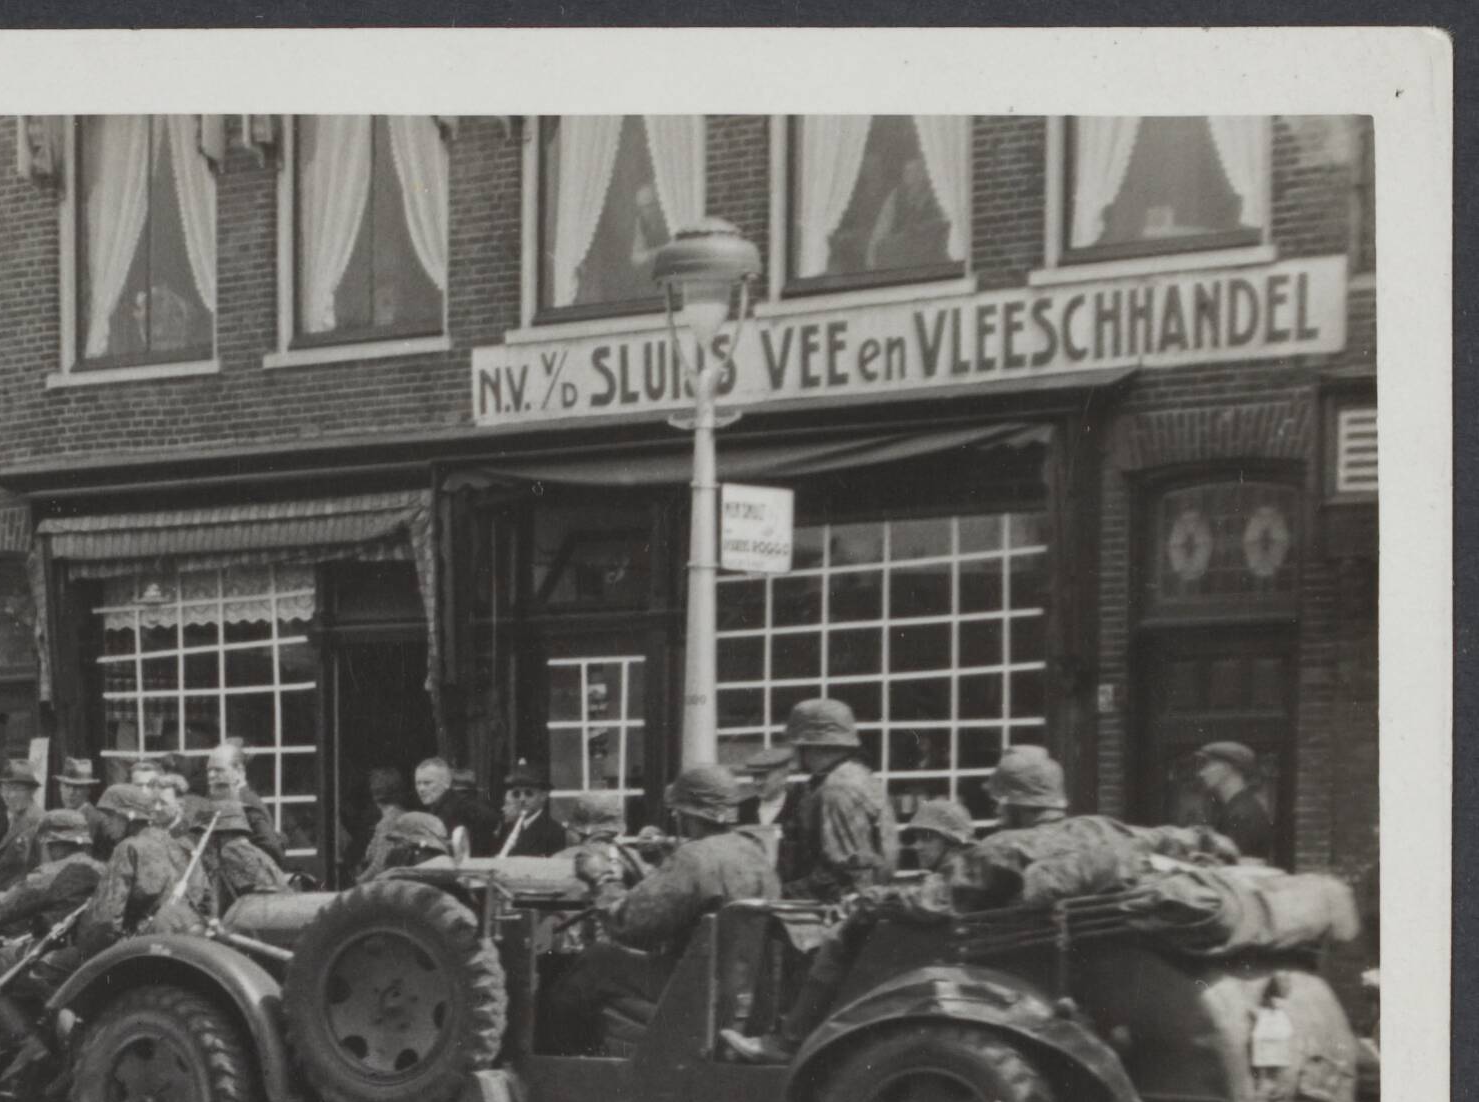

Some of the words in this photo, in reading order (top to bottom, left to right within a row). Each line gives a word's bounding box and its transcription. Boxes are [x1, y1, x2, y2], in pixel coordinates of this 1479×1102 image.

[478, 364, 532, 416] N.V.
[760, 320, 849, 391] VEE
[858, 335, 907, 382] en
[913, 272, 1319, 379] VLEESCHHANDEL
